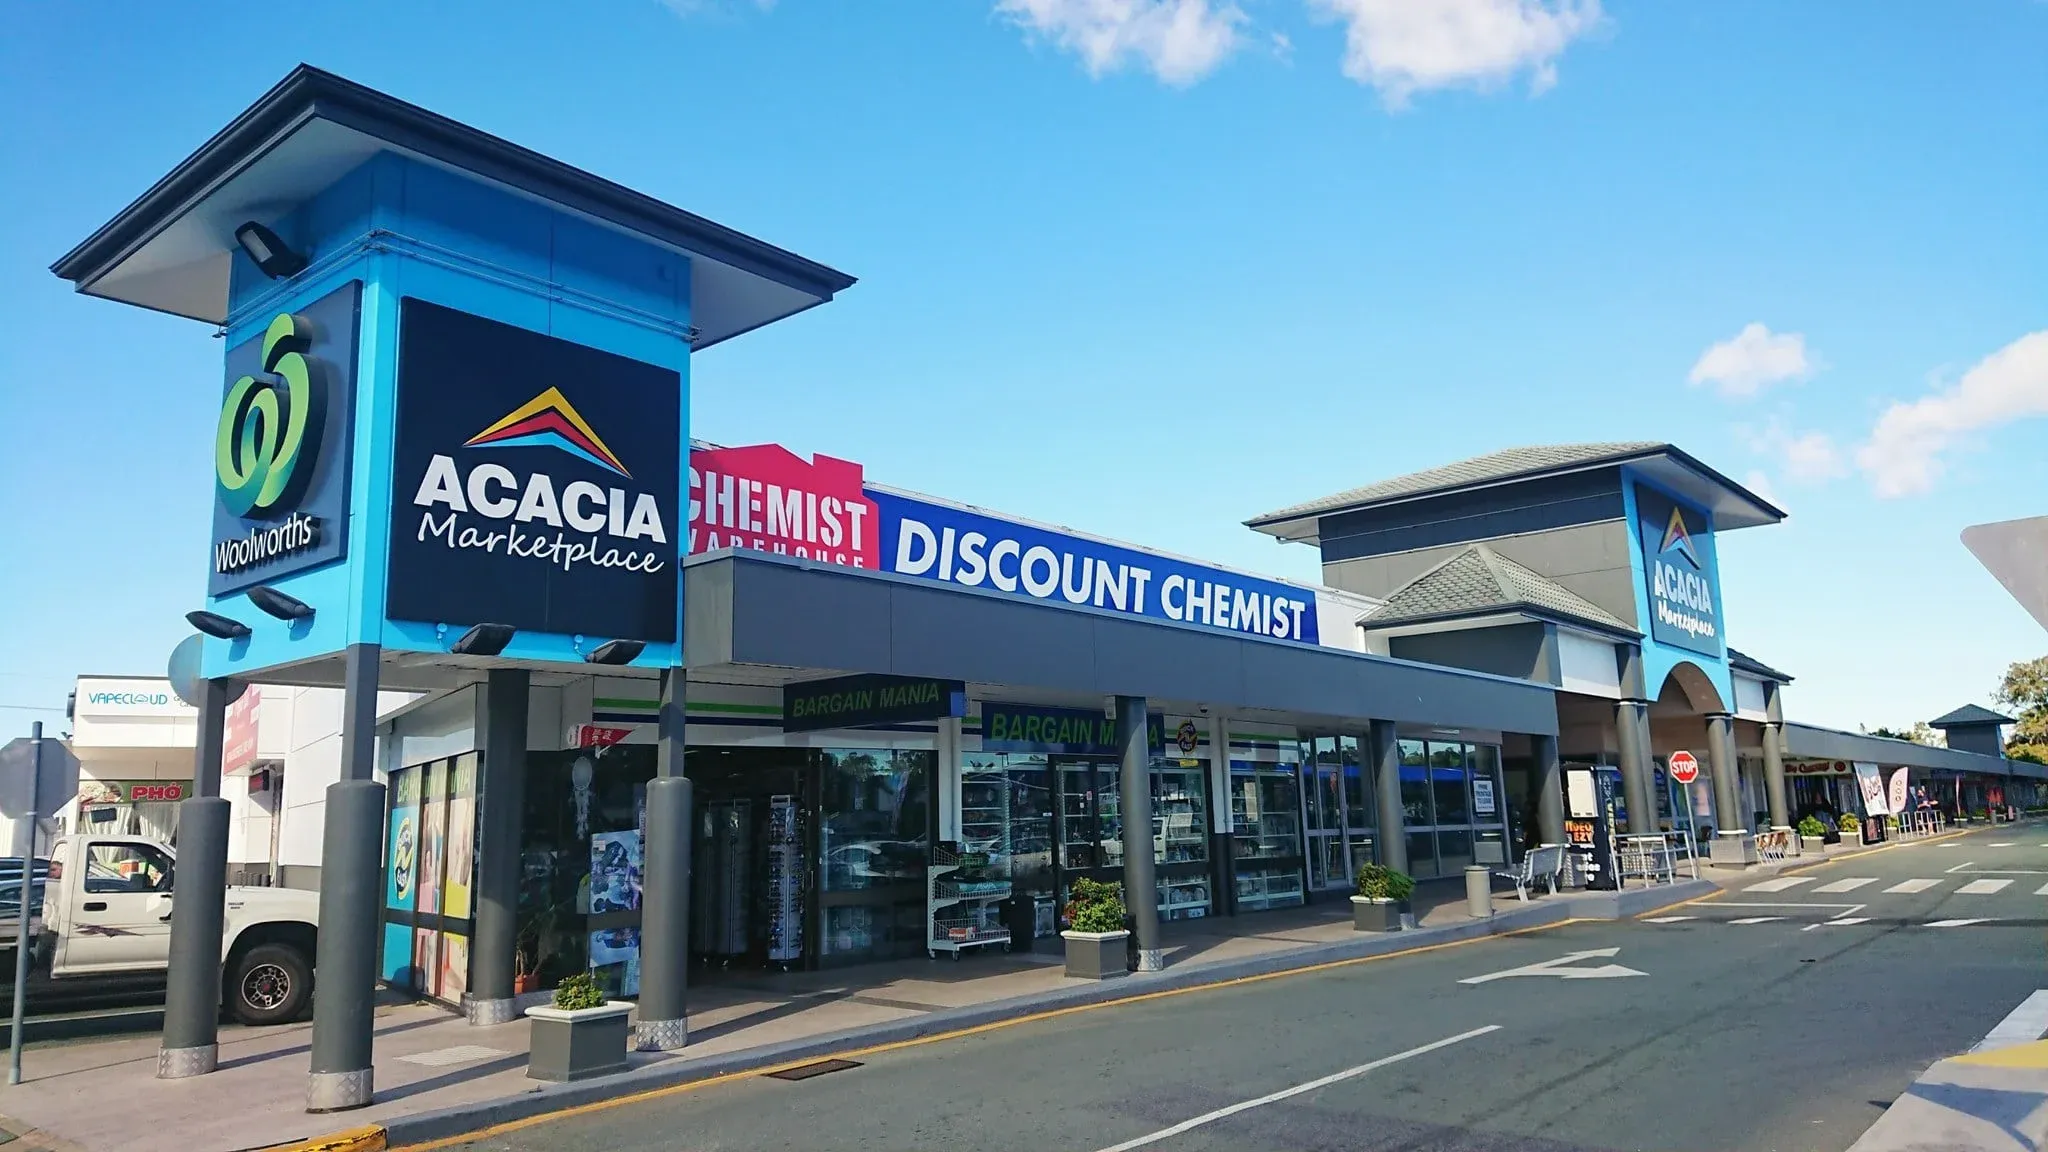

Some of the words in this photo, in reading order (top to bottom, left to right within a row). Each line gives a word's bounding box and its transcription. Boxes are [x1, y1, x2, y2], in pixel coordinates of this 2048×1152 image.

[413, 454, 667, 544] ACACIA
[215, 512, 312, 573] Woolworths
[417, 512, 665, 573] Marketplace
[895, 518, 1151, 613] DISCOUNT
[1160, 574, 1306, 640] CHEMIST
[1655, 560, 1713, 614] ACACIA
[1658, 599, 1715, 639] Marketplace
[793, 690, 873, 717] BARGAIN
[879, 683, 939, 708] MANIA
[991, 713, 1093, 745] BARGAIN
[1672, 760, 1695, 774] STOP
